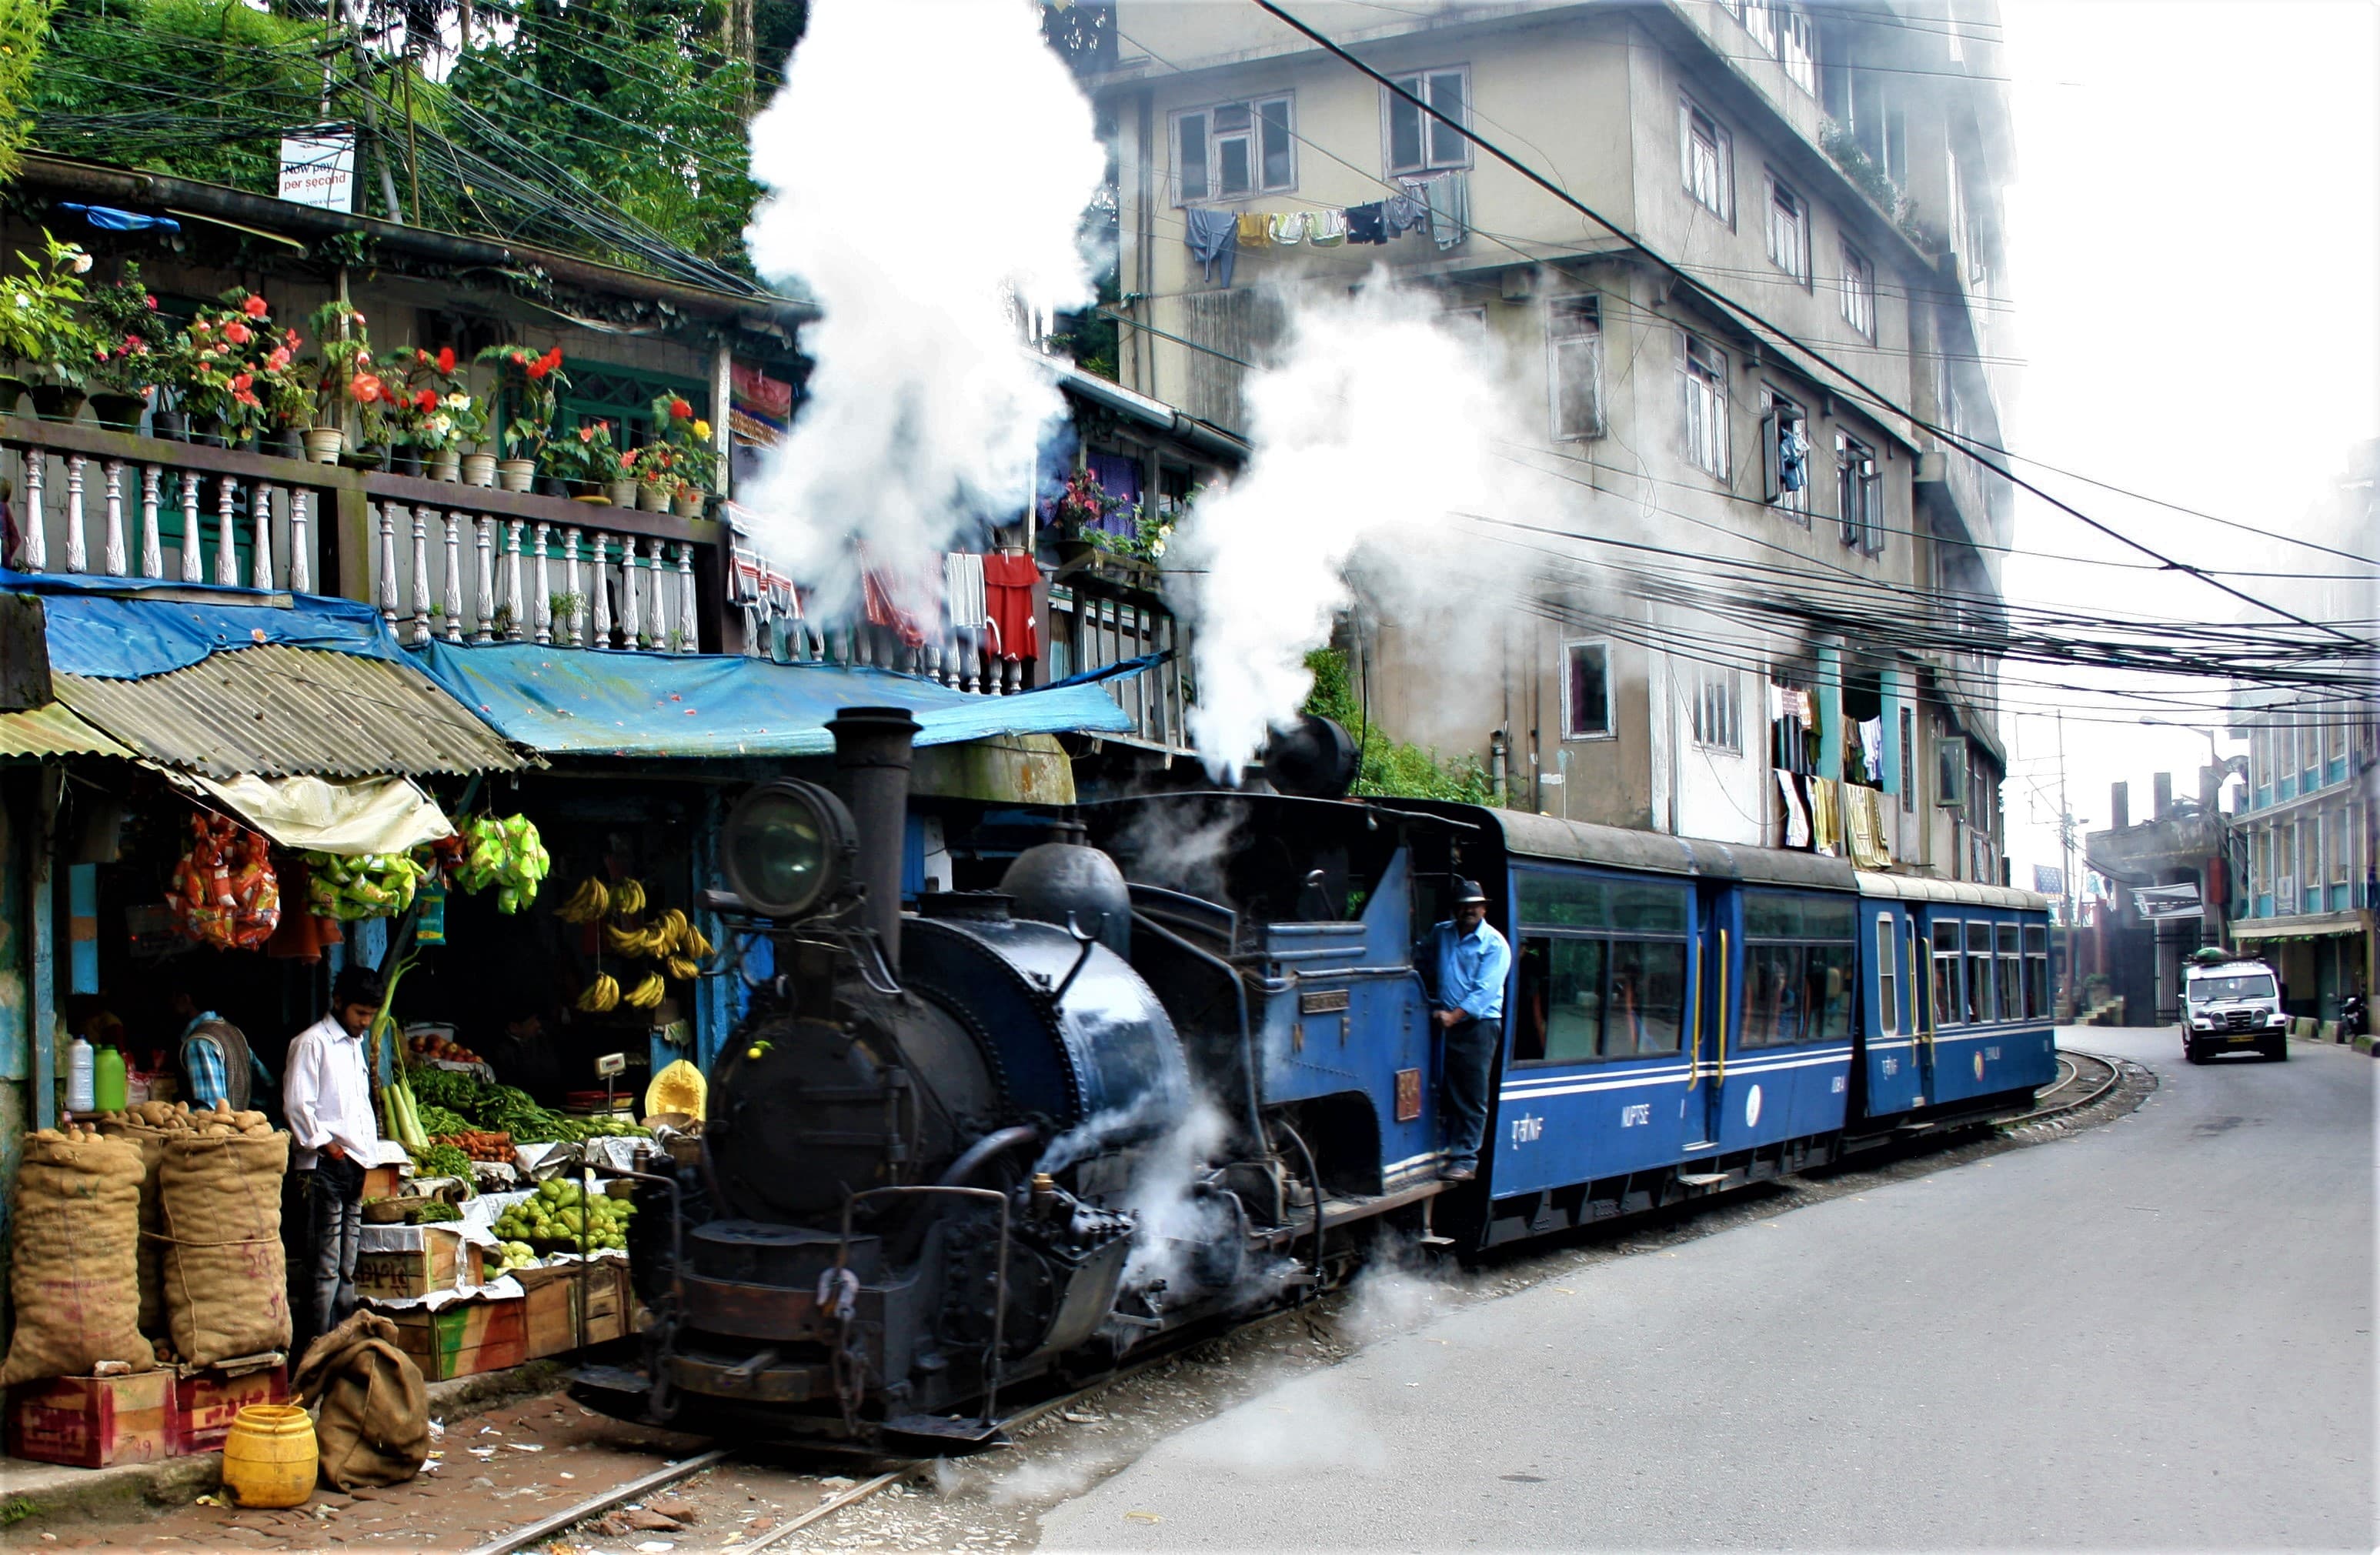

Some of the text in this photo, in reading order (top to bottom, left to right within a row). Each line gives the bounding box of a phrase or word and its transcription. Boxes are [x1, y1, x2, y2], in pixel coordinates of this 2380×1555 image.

[285, 162, 333, 176] Now pay
[284, 172, 346, 192] per second
